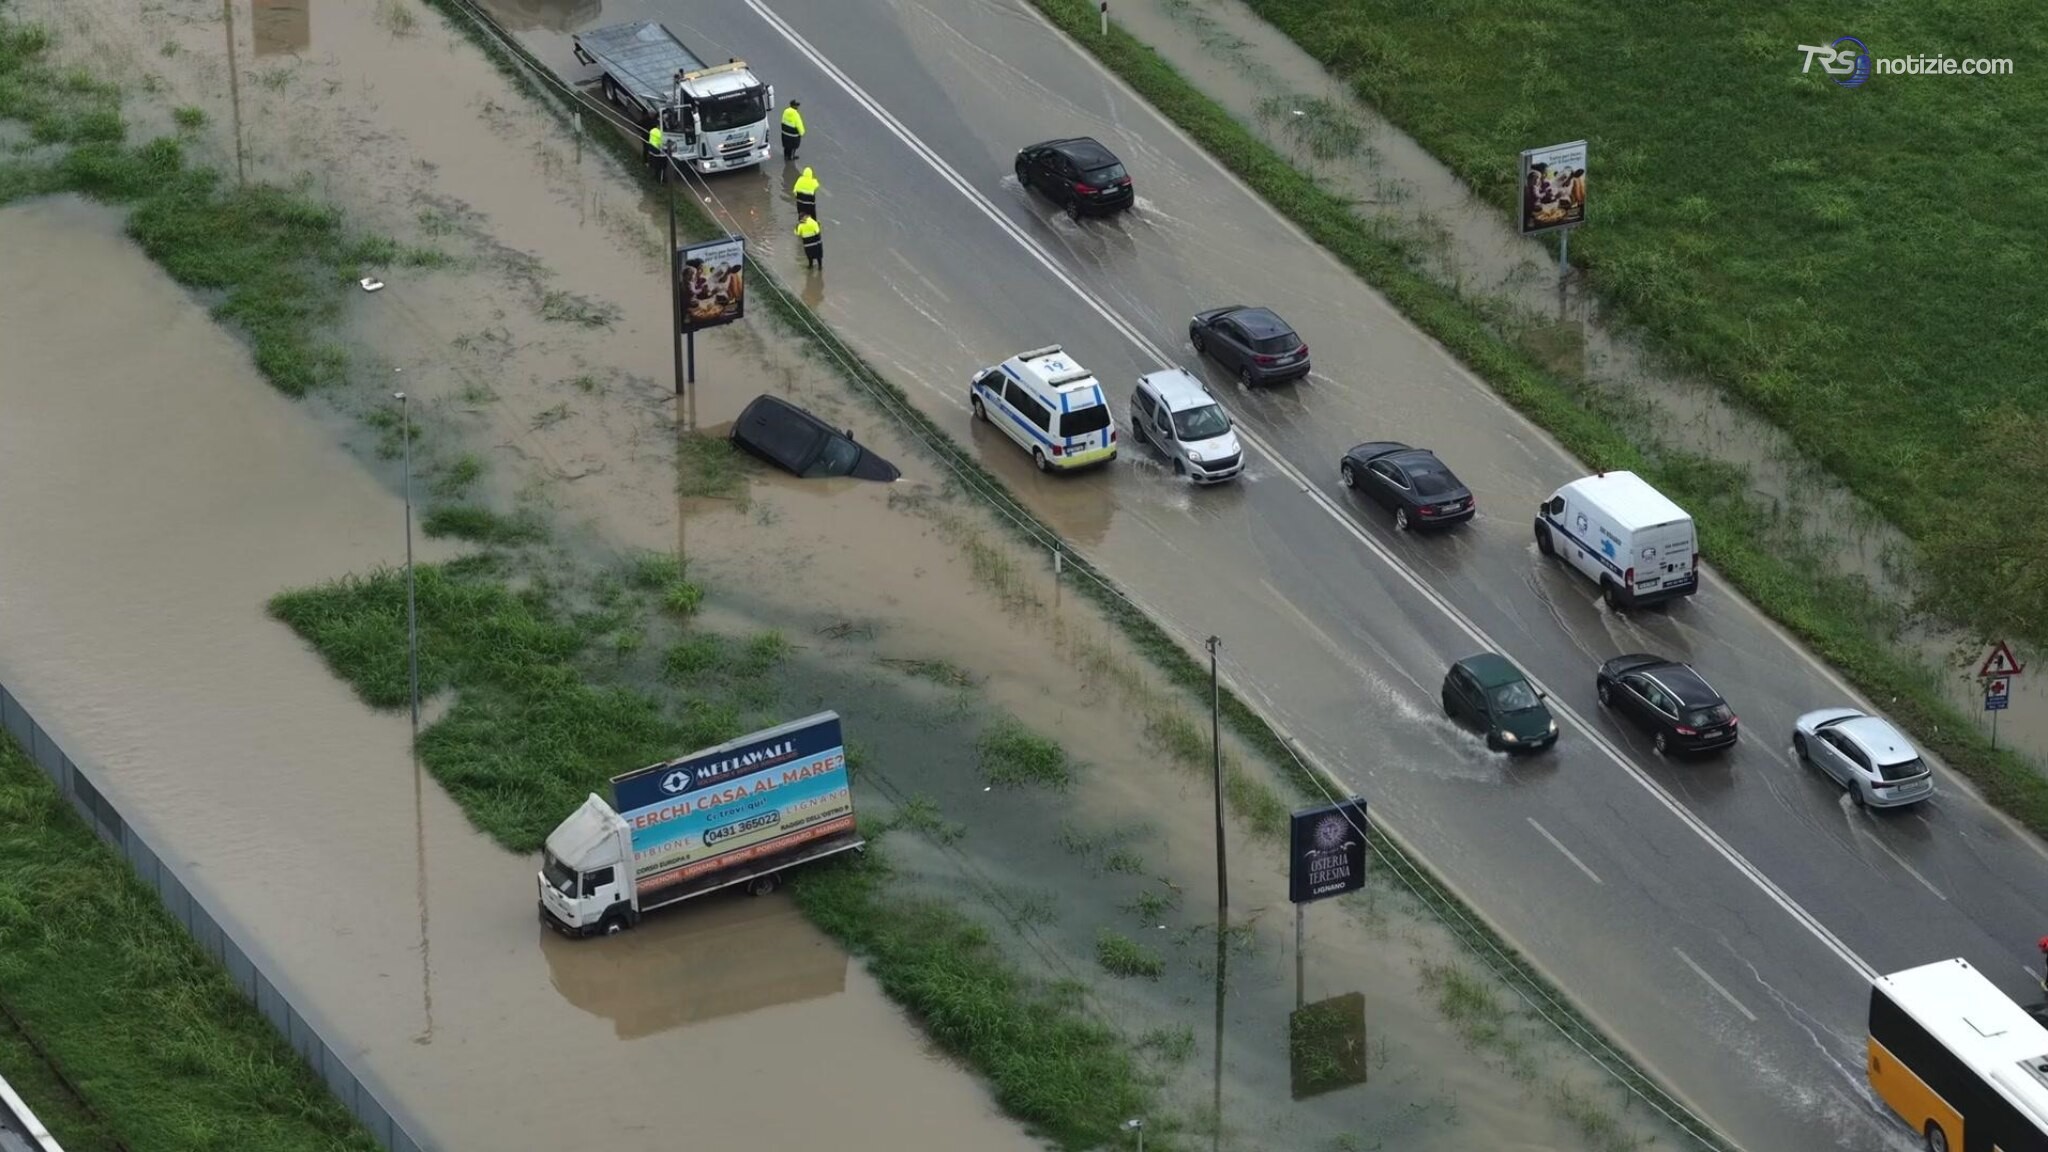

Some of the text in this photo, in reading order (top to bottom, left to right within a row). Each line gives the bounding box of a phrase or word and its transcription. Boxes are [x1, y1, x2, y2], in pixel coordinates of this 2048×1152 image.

[696, 741, 797, 780] MEDIAWALL
[697, 786, 747, 810] CASA
[754, 777, 777, 793] AL
[782, 755, 843, 784] MARE?
[719, 806, 744, 818] trovi
[747, 797, 767, 810] qui!
[785, 789, 847, 814] LIGNANO
[709, 812, 777, 841] 0431 365022
[634, 837, 692, 860] BIBIONE
[1311, 853, 1349, 872] OSTERIA
[1309, 865, 1351, 885] TERESINA
[1313, 882, 1346, 894] LIGNANO
